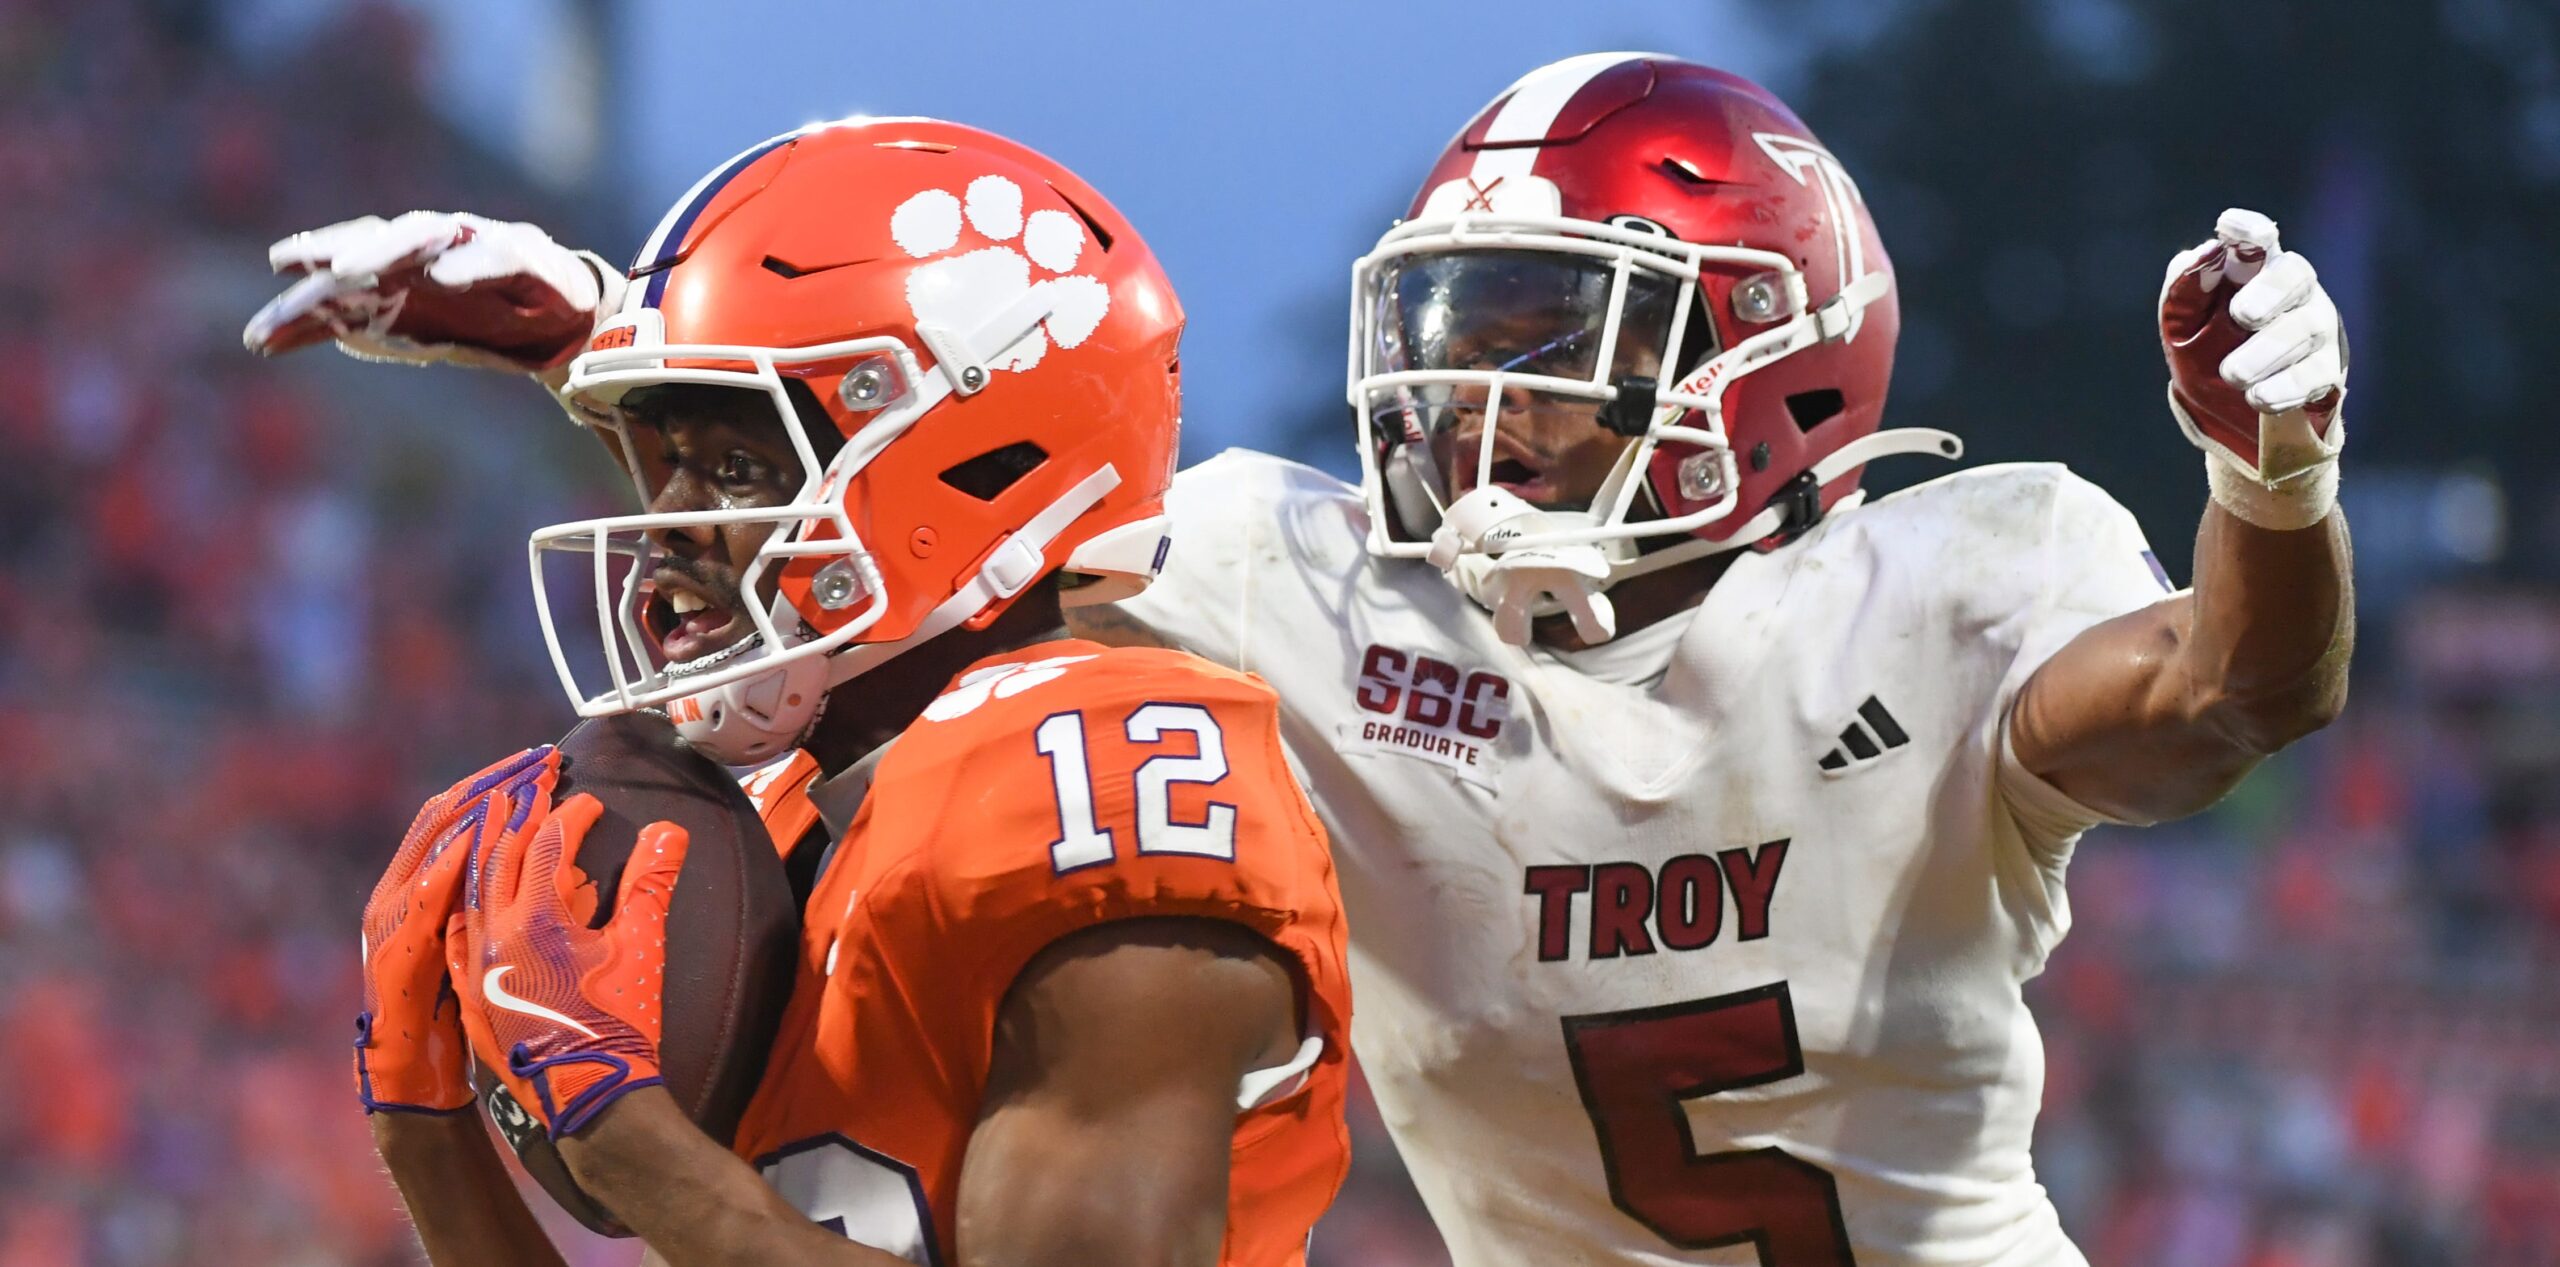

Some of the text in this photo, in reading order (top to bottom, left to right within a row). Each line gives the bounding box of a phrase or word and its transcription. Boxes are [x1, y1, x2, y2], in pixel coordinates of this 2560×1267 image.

[1356, 643, 1509, 740] SBC
[1362, 721, 1479, 766] GRADUATE
[1034, 702, 1237, 878] 12
[1524, 838, 1791, 962] TROY
[1560, 980, 1858, 1267] 5
